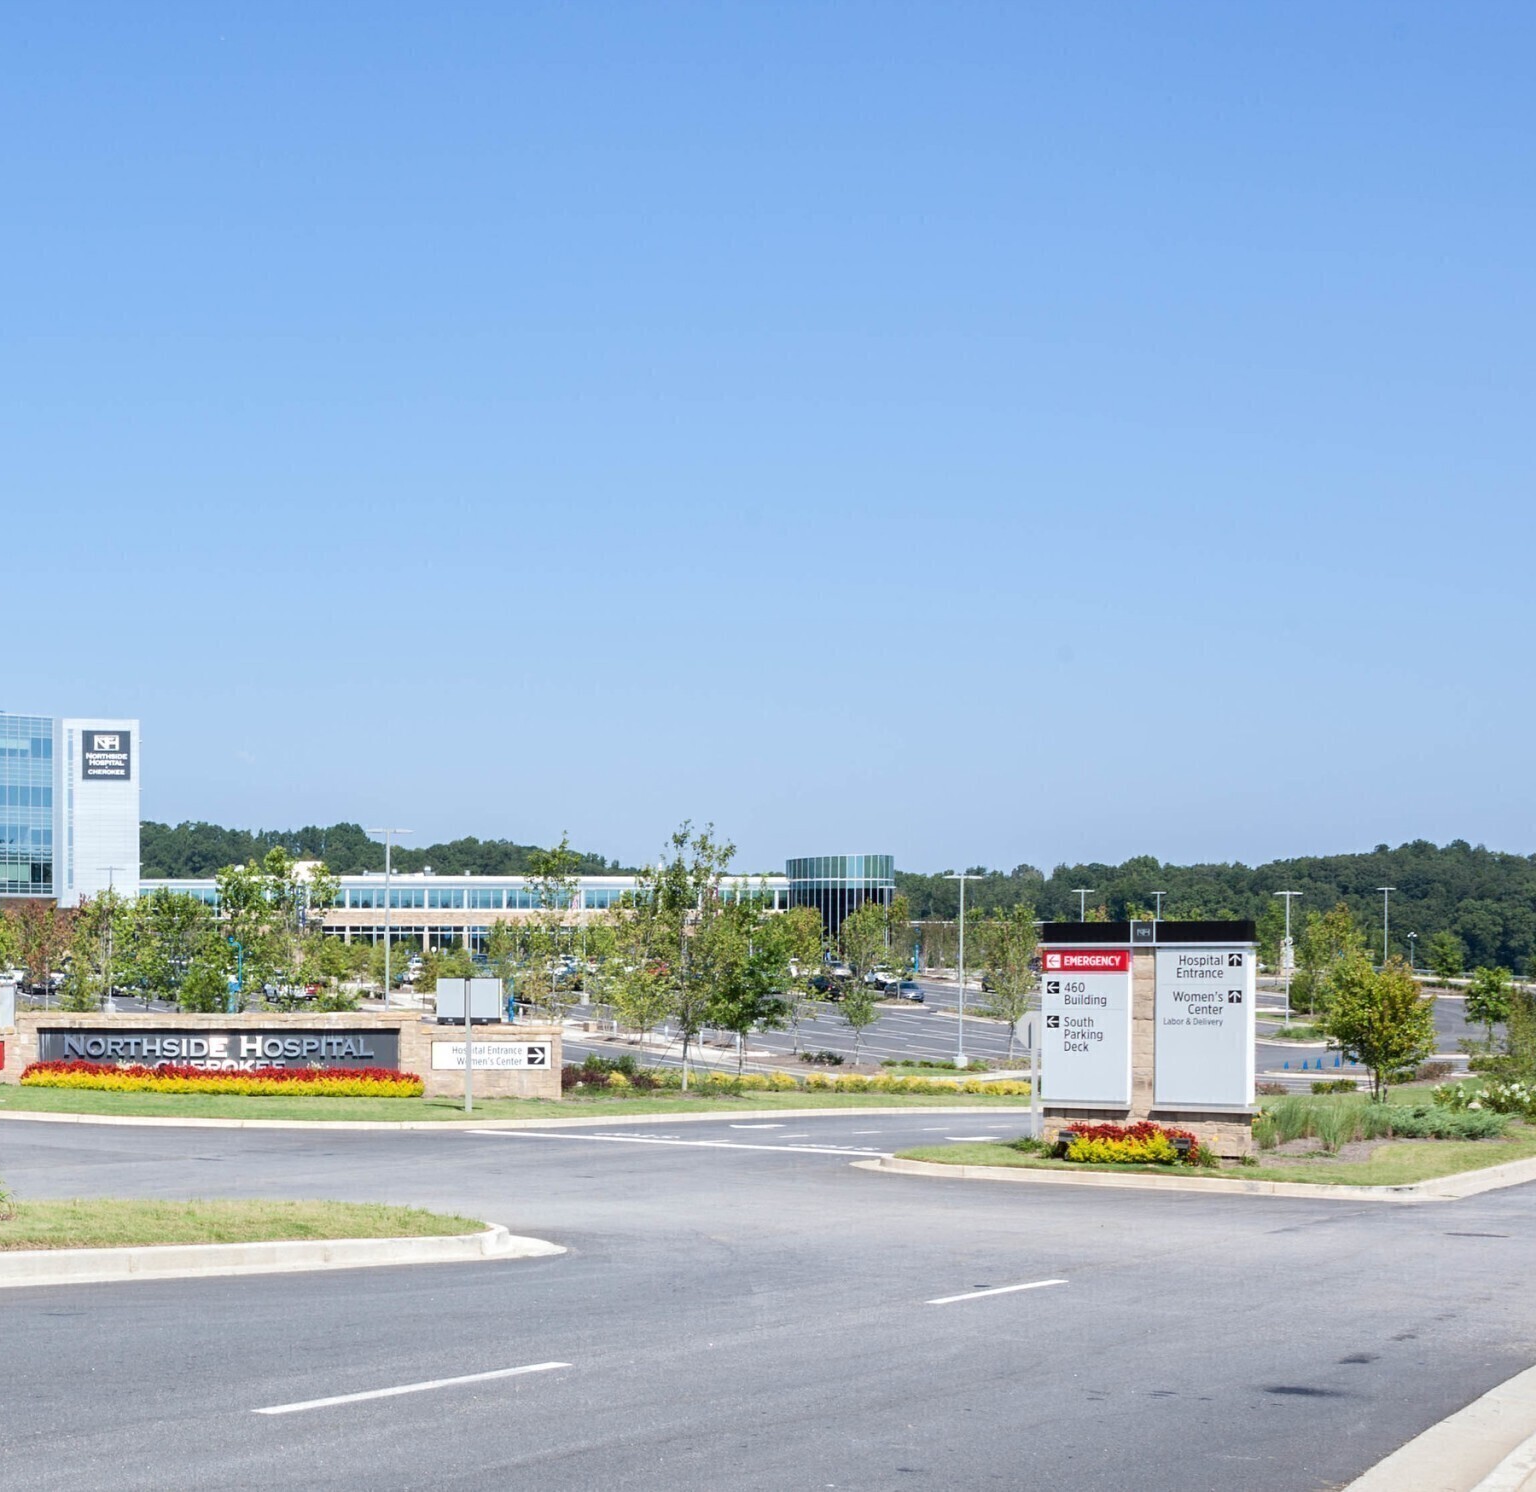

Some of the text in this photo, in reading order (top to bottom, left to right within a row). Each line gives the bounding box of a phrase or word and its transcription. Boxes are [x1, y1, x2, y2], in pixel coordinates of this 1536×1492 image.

[86, 752, 128, 760] NORTHSIDE
[1064, 955, 1121, 966] EMERGENCY
[1179, 955, 1223, 967] Hospital
[1176, 967, 1223, 978] Entrance
[1064, 982, 1085, 993] 460
[1064, 994, 1107, 1007] Building
[1173, 991, 1223, 1002] Women's
[1187, 1004, 1223, 1015] Center
[1064, 1016, 1094, 1027] South
[1163, 1018, 1223, 1027] Labor & Delivery
[1064, 1028, 1103, 1041] Parking
[64, 1035, 374, 1058] NORTHSIDE HOSPITAL
[452, 1046, 523, 1055] Hosital Entrance
[1064, 1041, 1089, 1052] Deck
[457, 1057, 523, 1066] Wmen's Center
